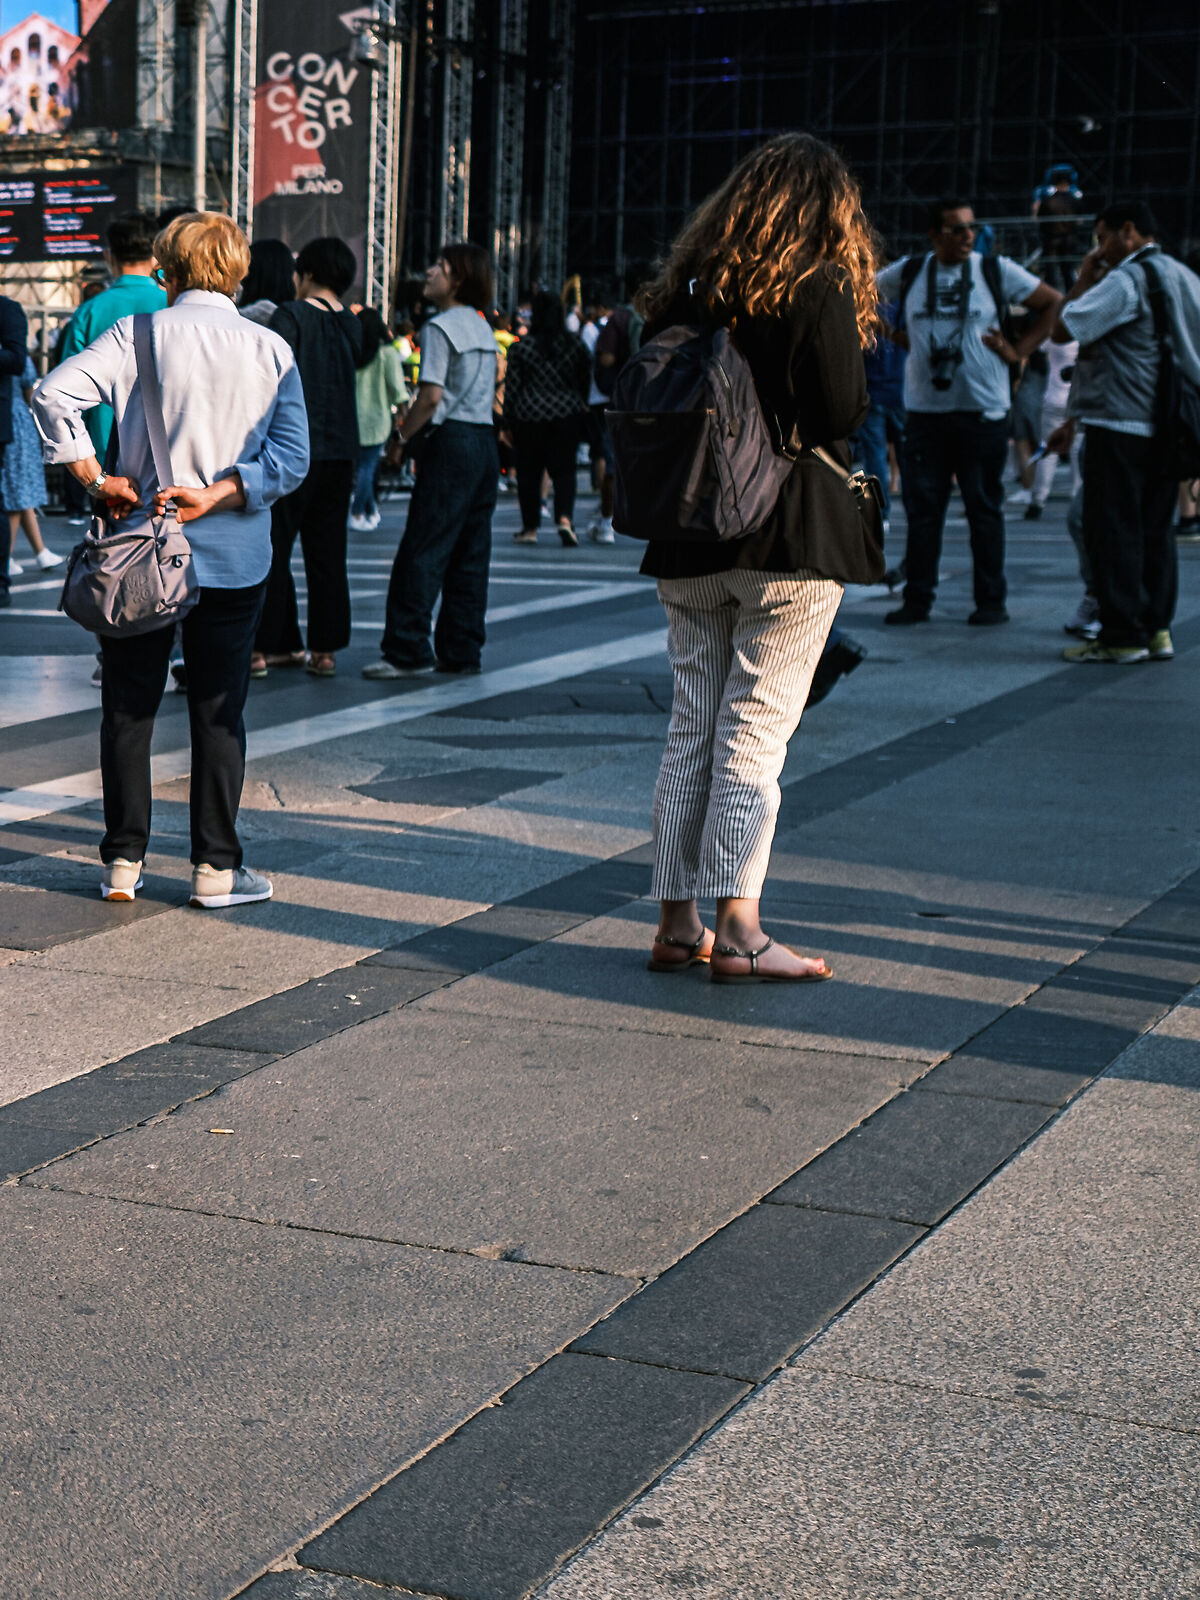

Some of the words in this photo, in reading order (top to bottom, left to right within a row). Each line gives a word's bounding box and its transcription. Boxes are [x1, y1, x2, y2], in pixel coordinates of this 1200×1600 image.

[266, 84, 353, 129] CER
[270, 113, 327, 149] TO
[291, 163, 327, 178] PER
[274, 179, 344, 195] MILANO
